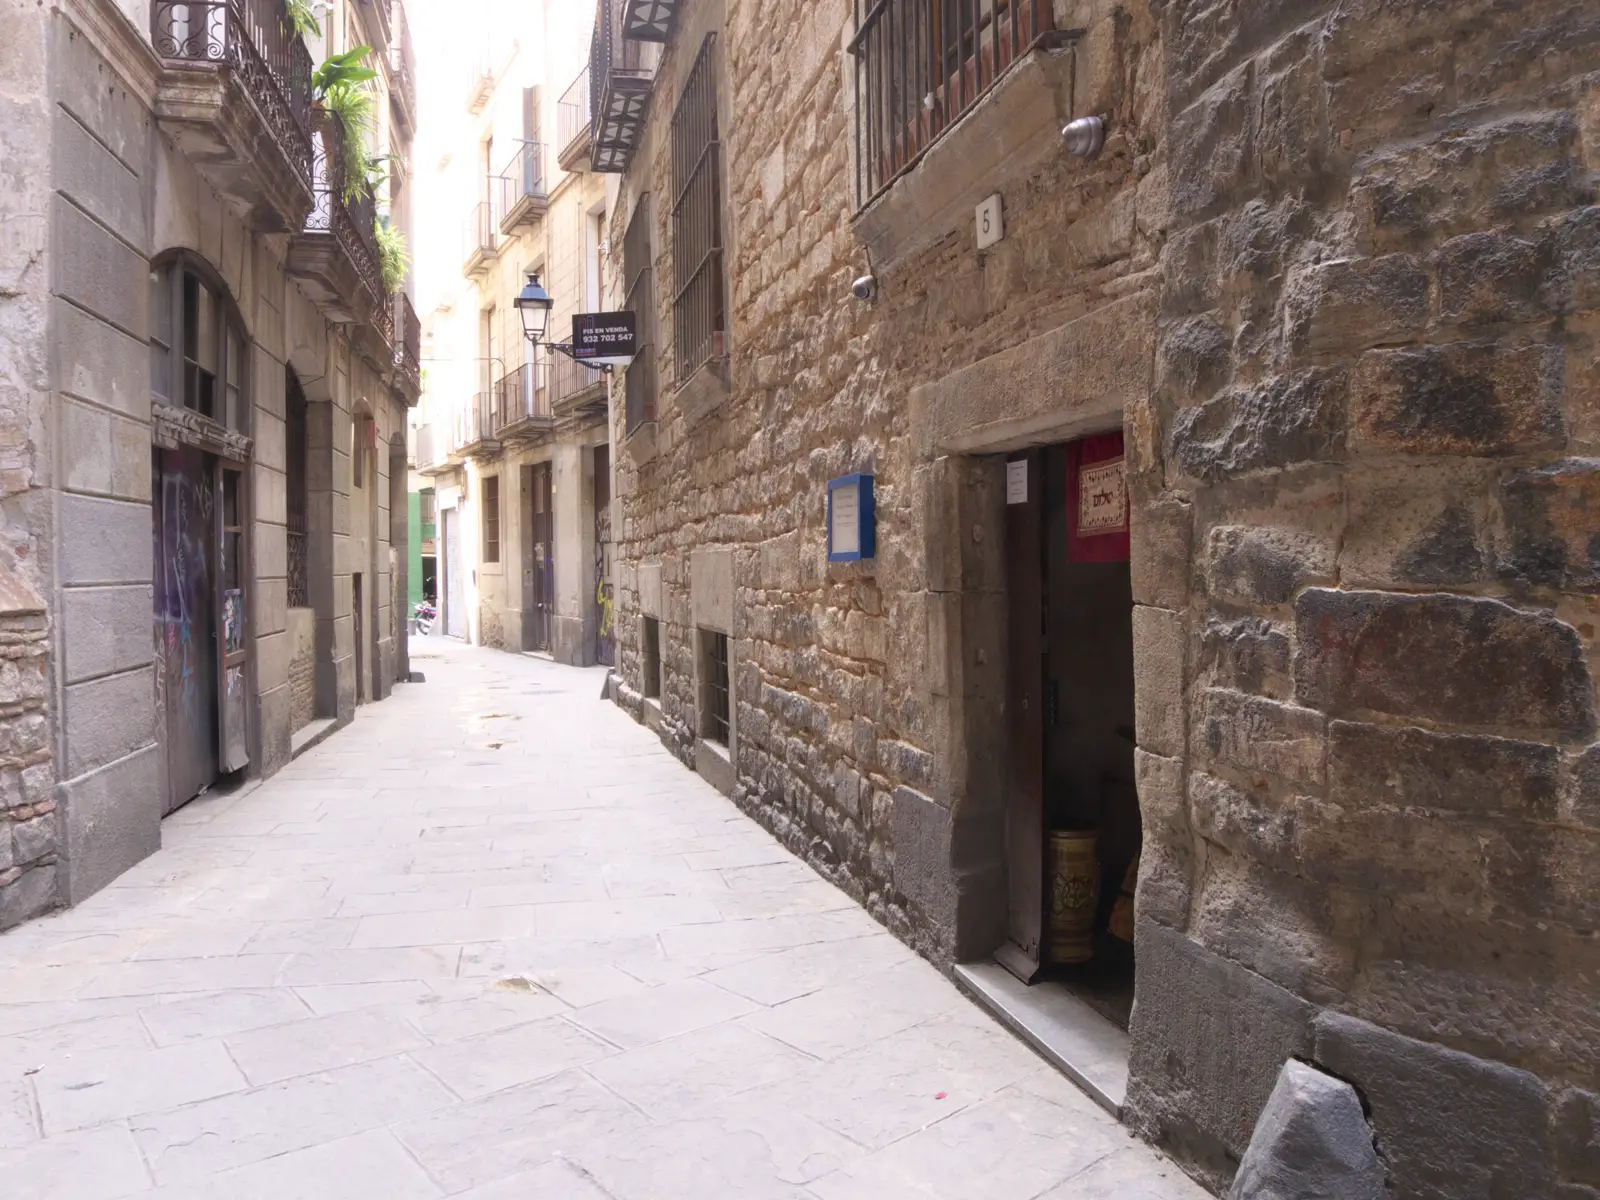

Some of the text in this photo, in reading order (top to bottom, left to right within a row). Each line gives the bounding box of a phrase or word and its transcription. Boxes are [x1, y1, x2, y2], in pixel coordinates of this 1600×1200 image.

[982, 207, 990, 234] 5
[582, 333, 633, 343] 932 702 547
